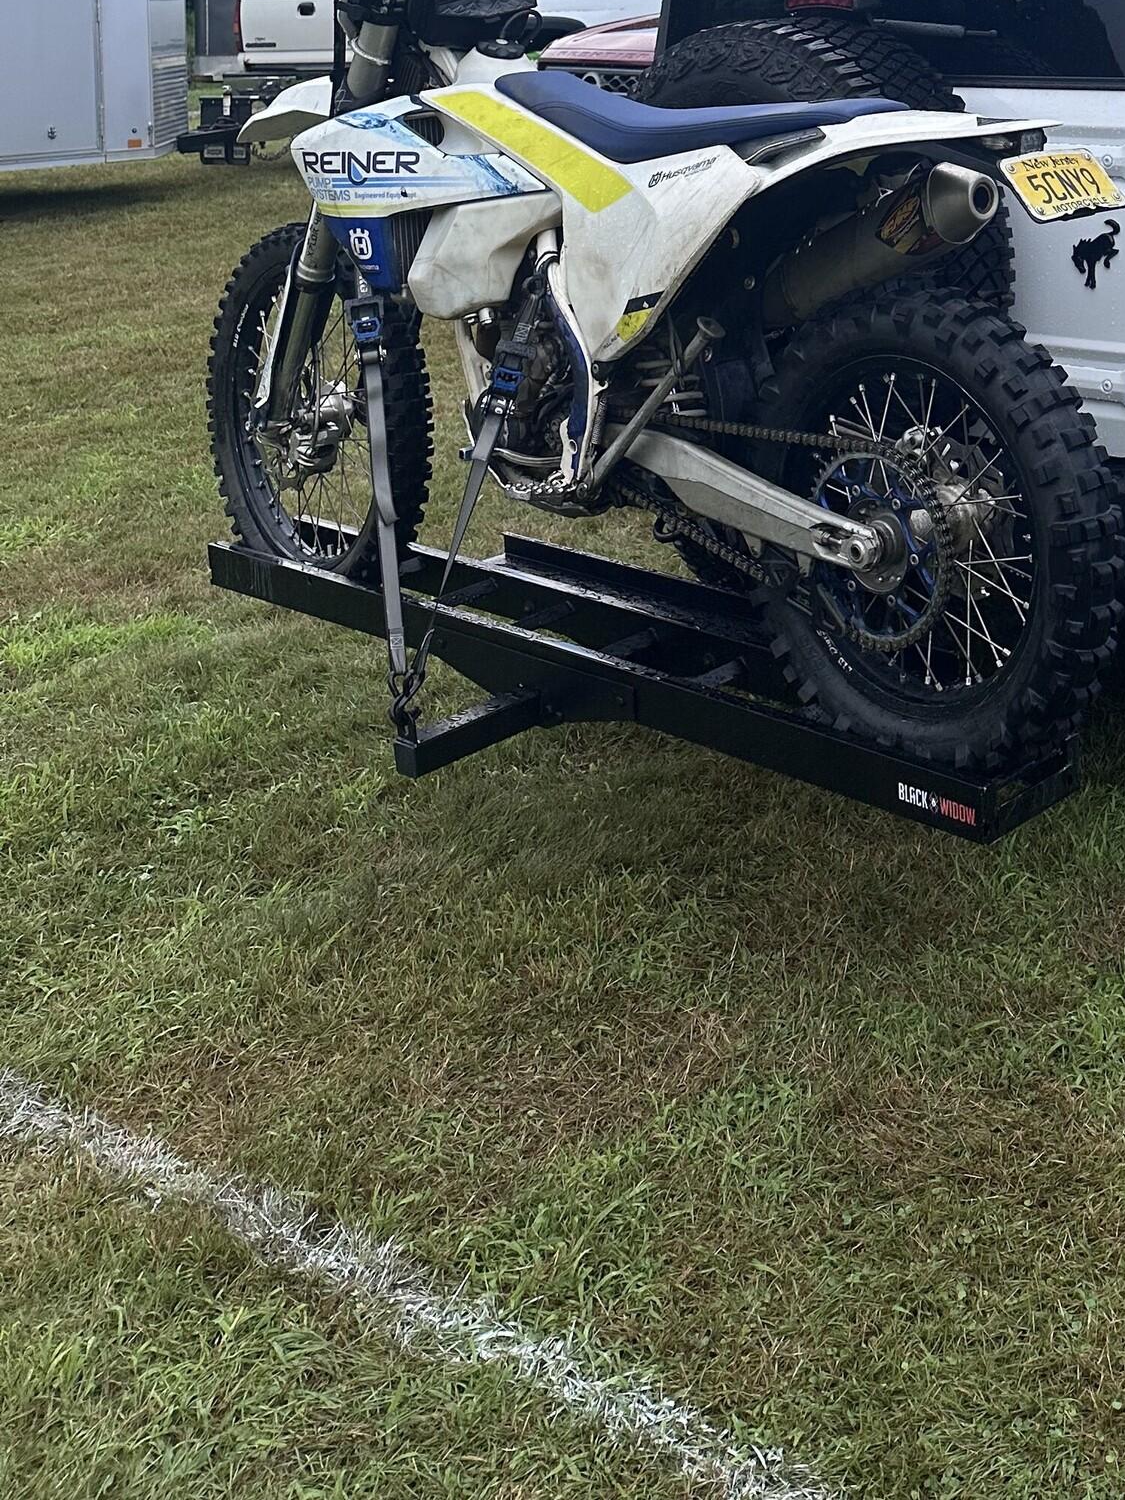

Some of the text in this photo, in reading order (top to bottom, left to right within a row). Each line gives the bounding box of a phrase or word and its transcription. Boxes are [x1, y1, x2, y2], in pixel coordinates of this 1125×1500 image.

[302, 151, 420, 185] REINER
[660, 157, 718, 183] Husqvarna
[1021, 155, 1080, 172] New Jersey
[307, 176, 331, 189] PUMP
[1026, 167, 1101, 204] 5CNY9
[311, 188, 351, 202] SYSTEMS
[1052, 196, 1109, 214] MOTORCYCLE
[898, 782, 976, 826] BLACK WIDOW
